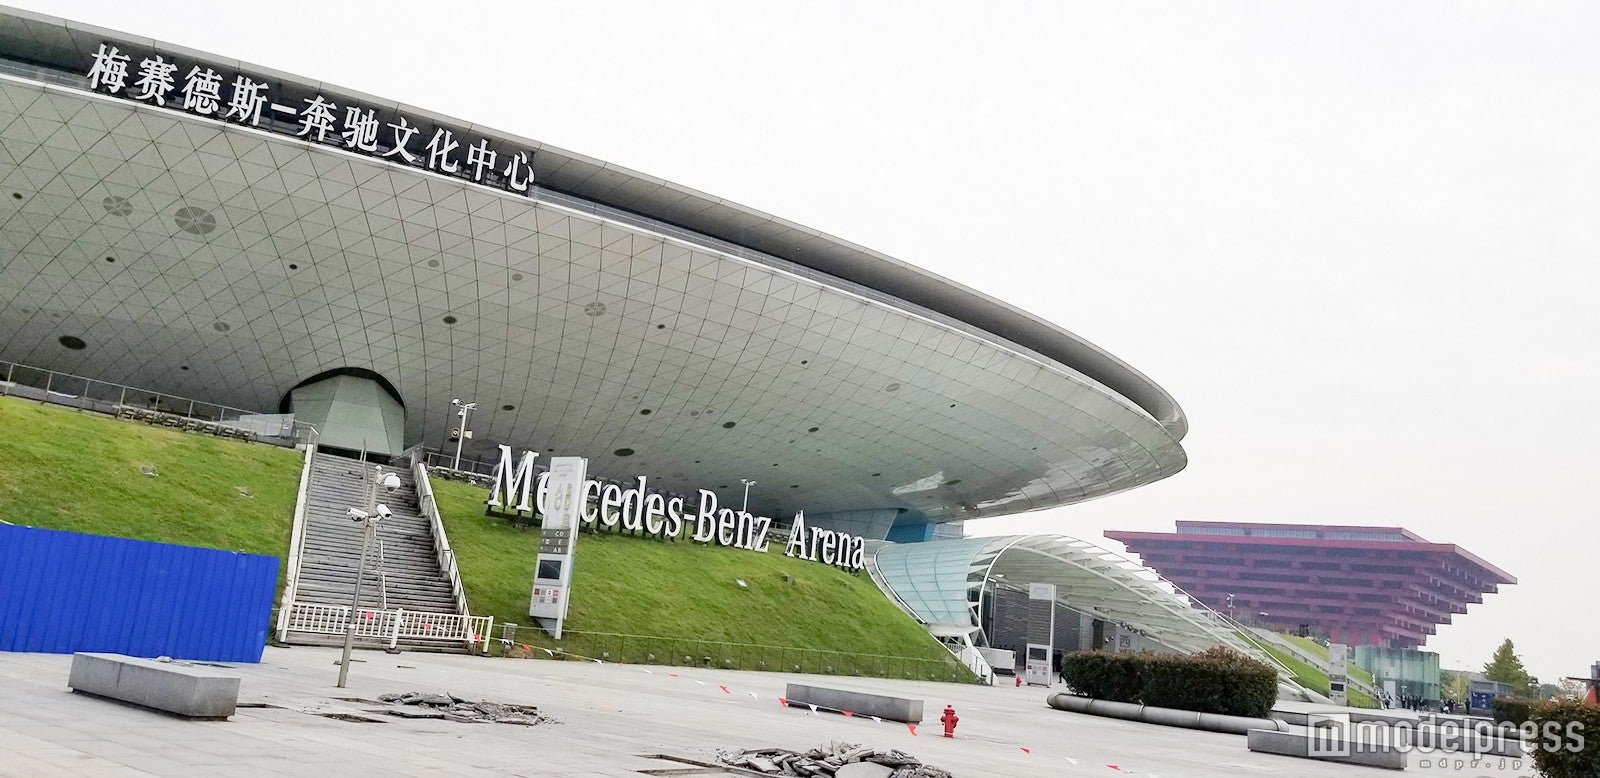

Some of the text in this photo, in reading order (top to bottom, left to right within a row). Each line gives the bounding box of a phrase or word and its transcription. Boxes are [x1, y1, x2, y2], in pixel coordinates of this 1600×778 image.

[86, 43, 535, 191] 梅赛德斯-奔驰文化中心
[488, 443, 866, 571] Mecedes-Benz Arena
